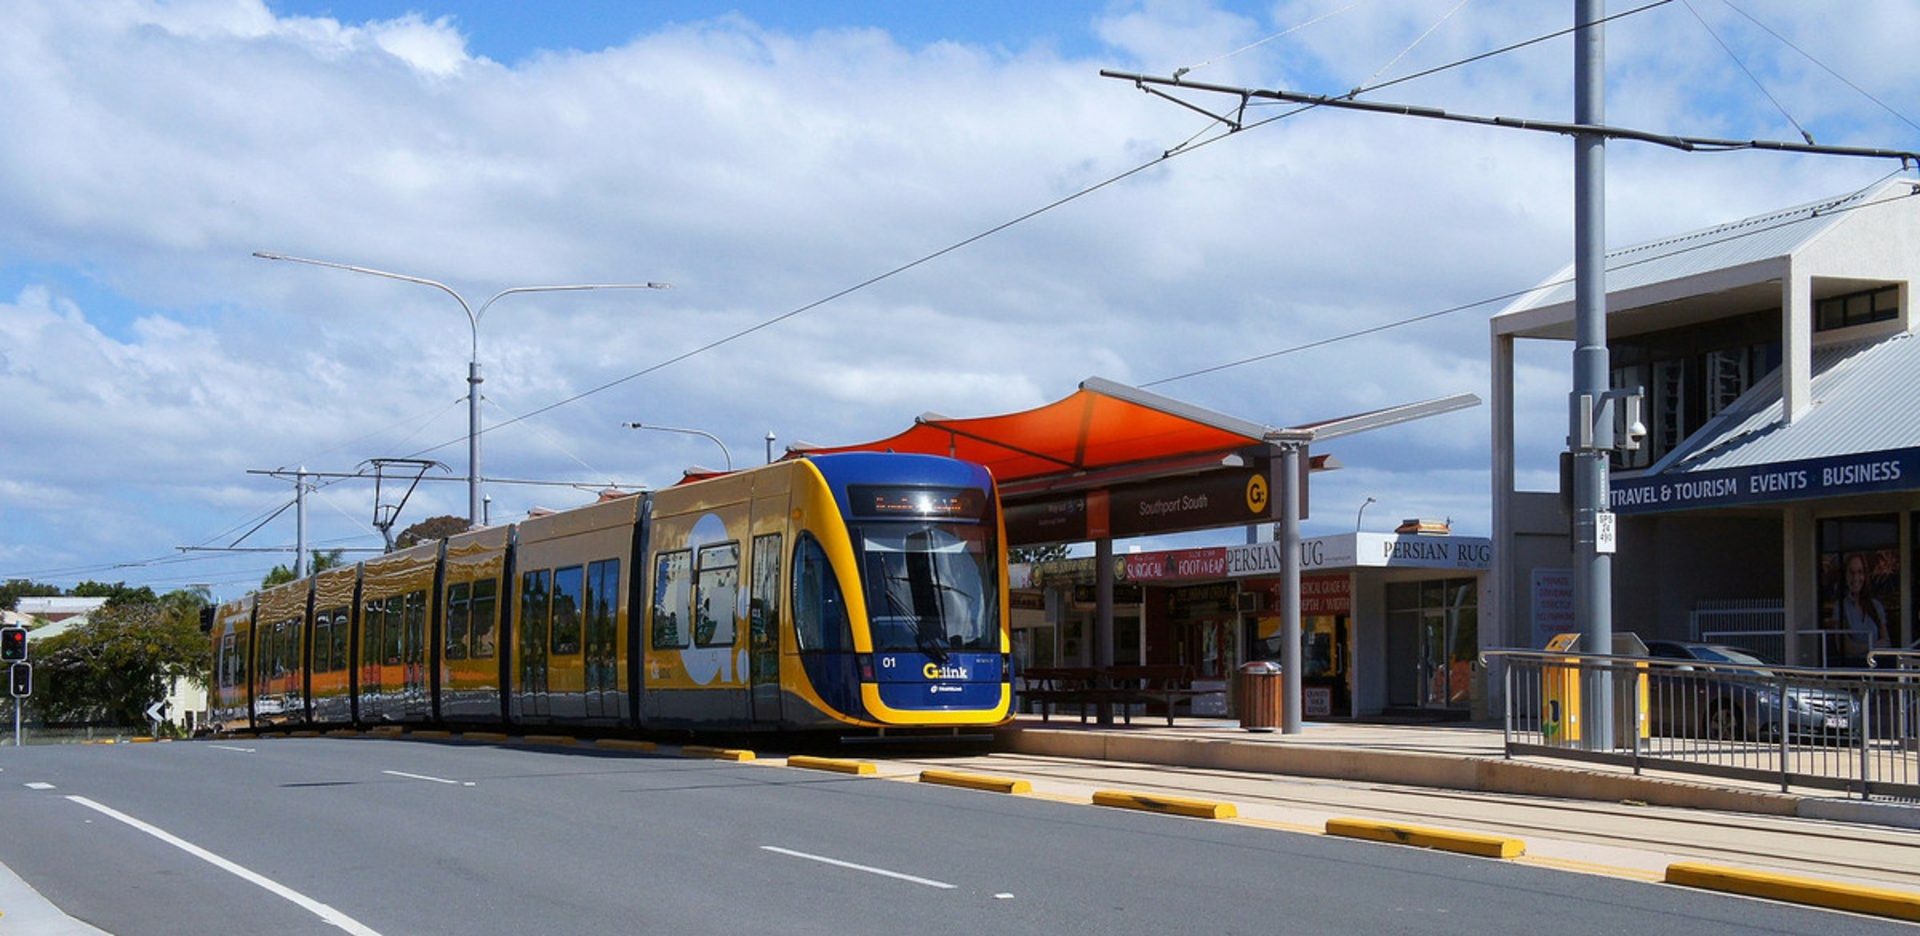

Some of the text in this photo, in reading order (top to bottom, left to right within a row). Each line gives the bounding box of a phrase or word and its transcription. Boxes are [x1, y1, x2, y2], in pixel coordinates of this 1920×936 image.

[1610, 461, 1901, 506] TRAVEL & TOURISM EVENTS BUSINESS
[1139, 494, 1209, 516] Southport South
[1227, 541, 1324, 572] PERSIAN UG
[1384, 541, 1491, 562] PERSIAN RUG
[1179, 557, 1225, 575] FOOTWEAR
[882, 657, 896, 668] 01
[923, 662, 968, 680] G:link
